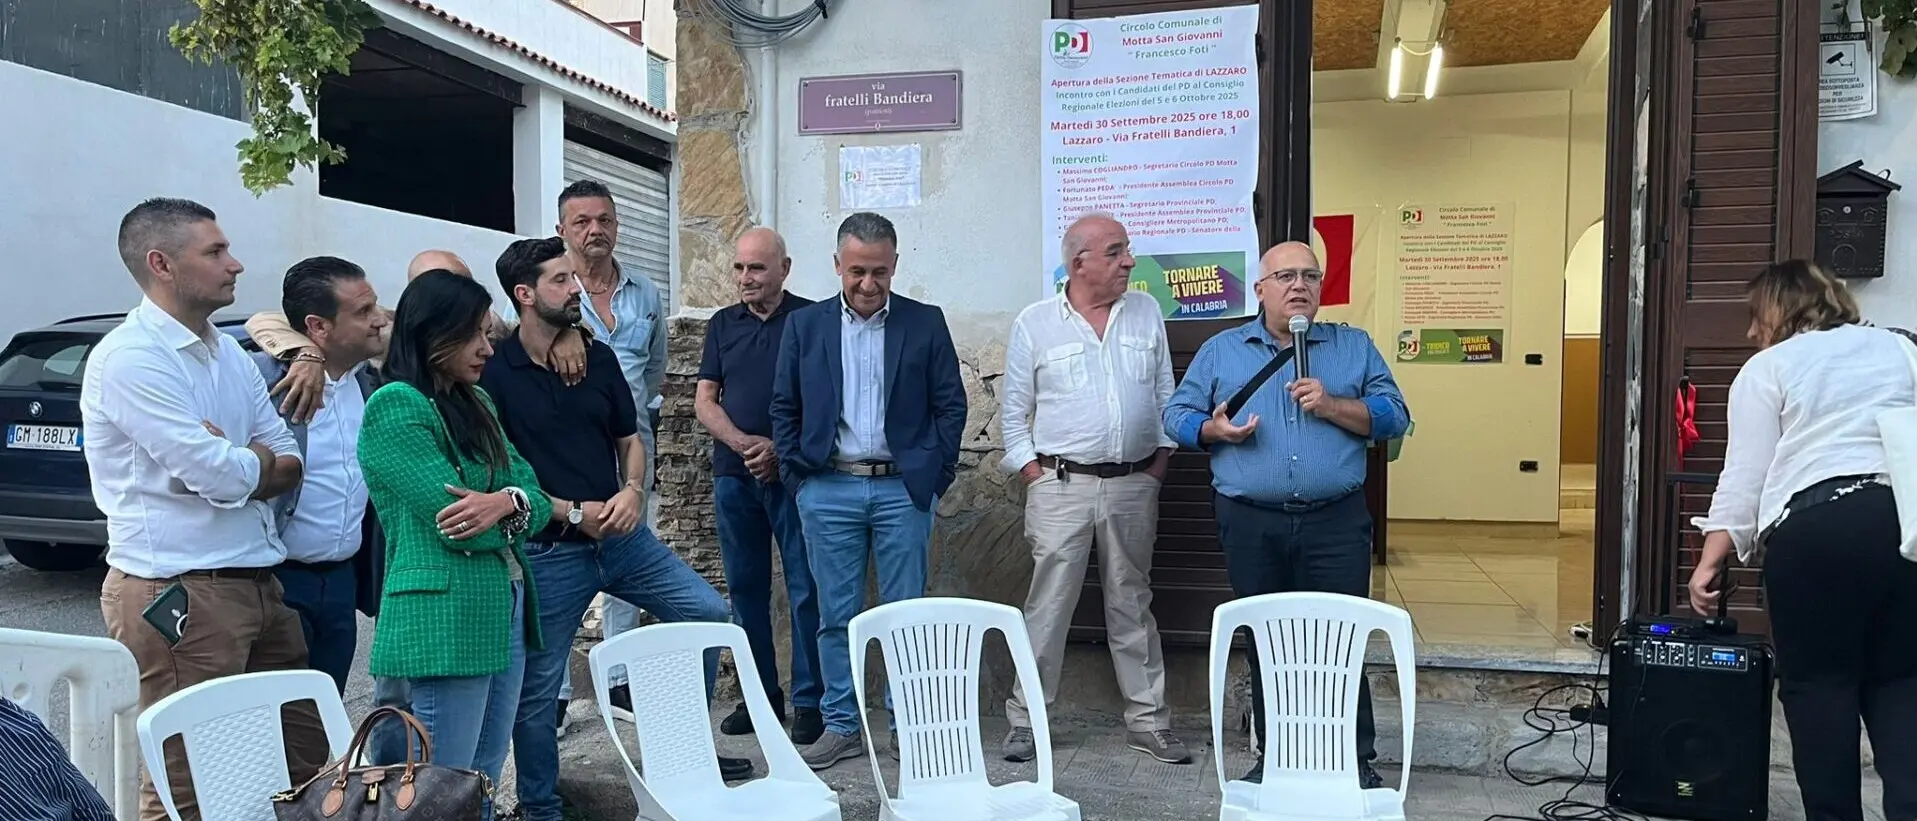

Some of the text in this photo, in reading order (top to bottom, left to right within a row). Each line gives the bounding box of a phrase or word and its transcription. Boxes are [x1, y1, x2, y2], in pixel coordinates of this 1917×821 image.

[1120, 15, 1222, 32] Circolo Comunale di
[1122, 29, 1223, 46] Motta San Giovanni
[1135, 47, 1186, 59] Francesco
[1189, 44, 1208, 55] Foti
[871, 82, 885, 91] via
[1051, 67, 1247, 88] Apertura della Sezione Tematica di LAZZARO
[1056, 91, 1093, 99] Incontro
[1118, 85, 1160, 96] Candidati
[1162, 83, 1176, 92] del
[1178, 82, 1191, 90] PD
[1193, 81, 1201, 89] al
[1203, 79, 1245, 90] Consiglio
[825, 91, 933, 107] fratelli Bandiera
[1062, 102, 1104, 112] Regionale
[1106, 99, 1139, 108] Elezioni
[1142, 97, 1155, 106] del
[1180, 94, 1215, 102] Ottobre
[1218, 92, 1239, 100] 2025
[1050, 109, 1250, 131] Martedì 30 Settembre 2025 ore 18,00
[1062, 135, 1104, 145] Lazzaro
[1112, 132, 1129, 142] Via
[1132, 129, 1171, 141] Fratelli
[1174, 127, 1227, 138] Bandiera,
[1230, 125, 1236, 134] 1
[1052, 153, 1109, 165] Interventi:
[1163, 264, 1219, 285] TORNARE
[1171, 279, 1224, 299] A VIVERE
[1181, 300, 1228, 314] IN CALABRIA
[16, 426, 76, 445] GM 188LX
